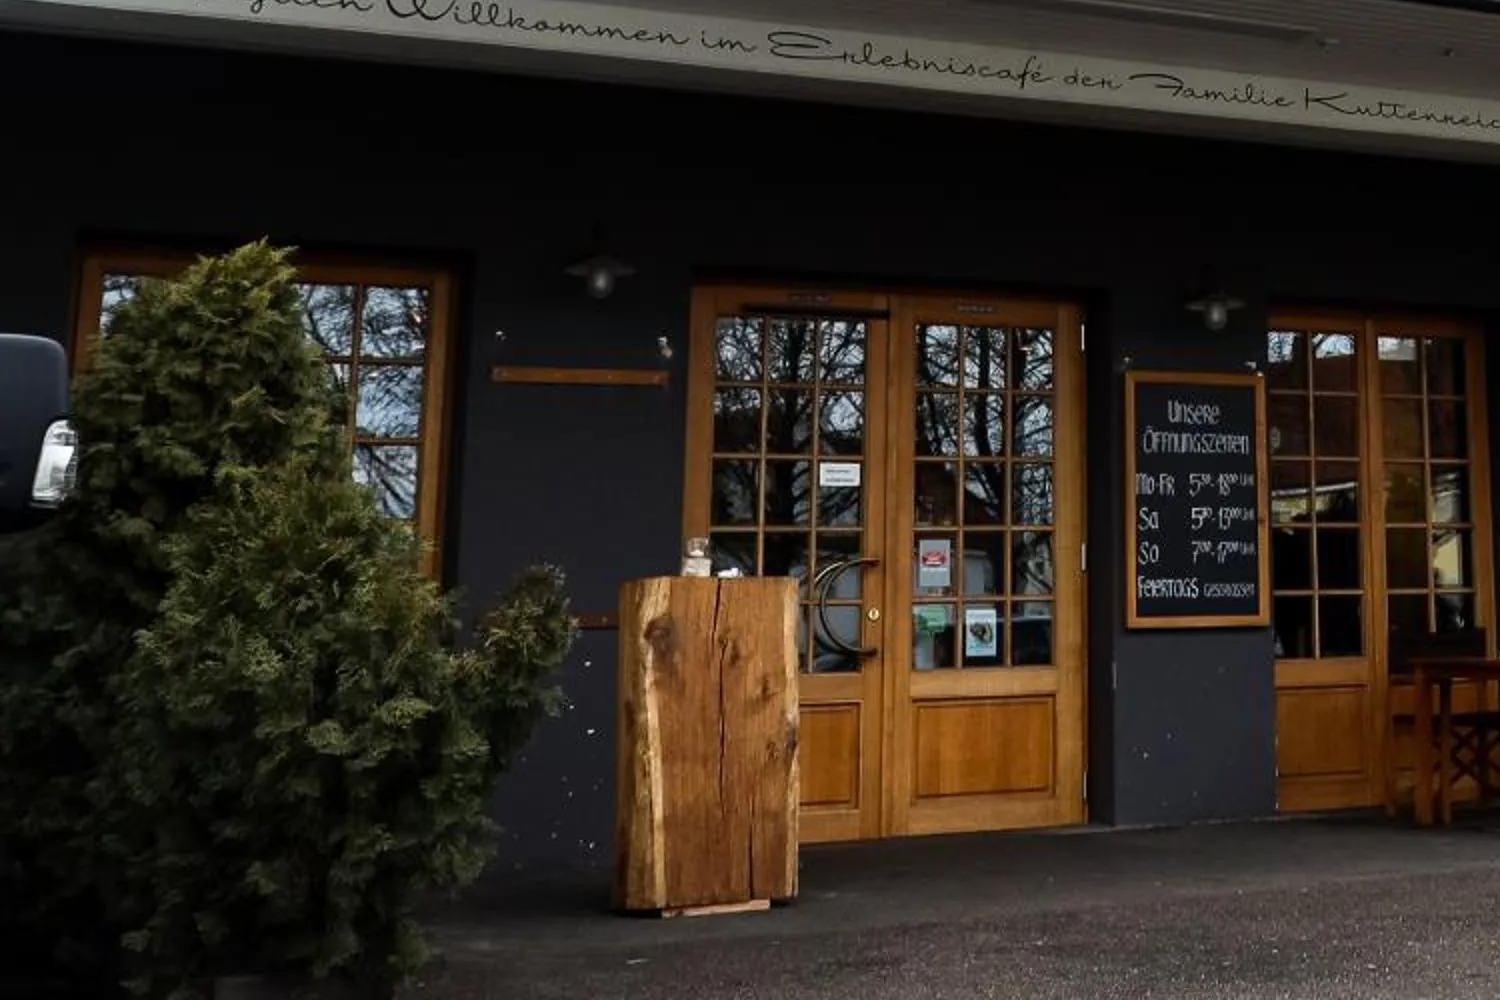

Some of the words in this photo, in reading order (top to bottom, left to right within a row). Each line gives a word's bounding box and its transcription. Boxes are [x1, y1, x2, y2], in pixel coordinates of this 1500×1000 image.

[701, 30, 757, 53] im
[767, 32, 1052, 89] Erlebniscafé
[1063, 67, 1124, 90] der
[1128, 73, 1294, 108] Familie
